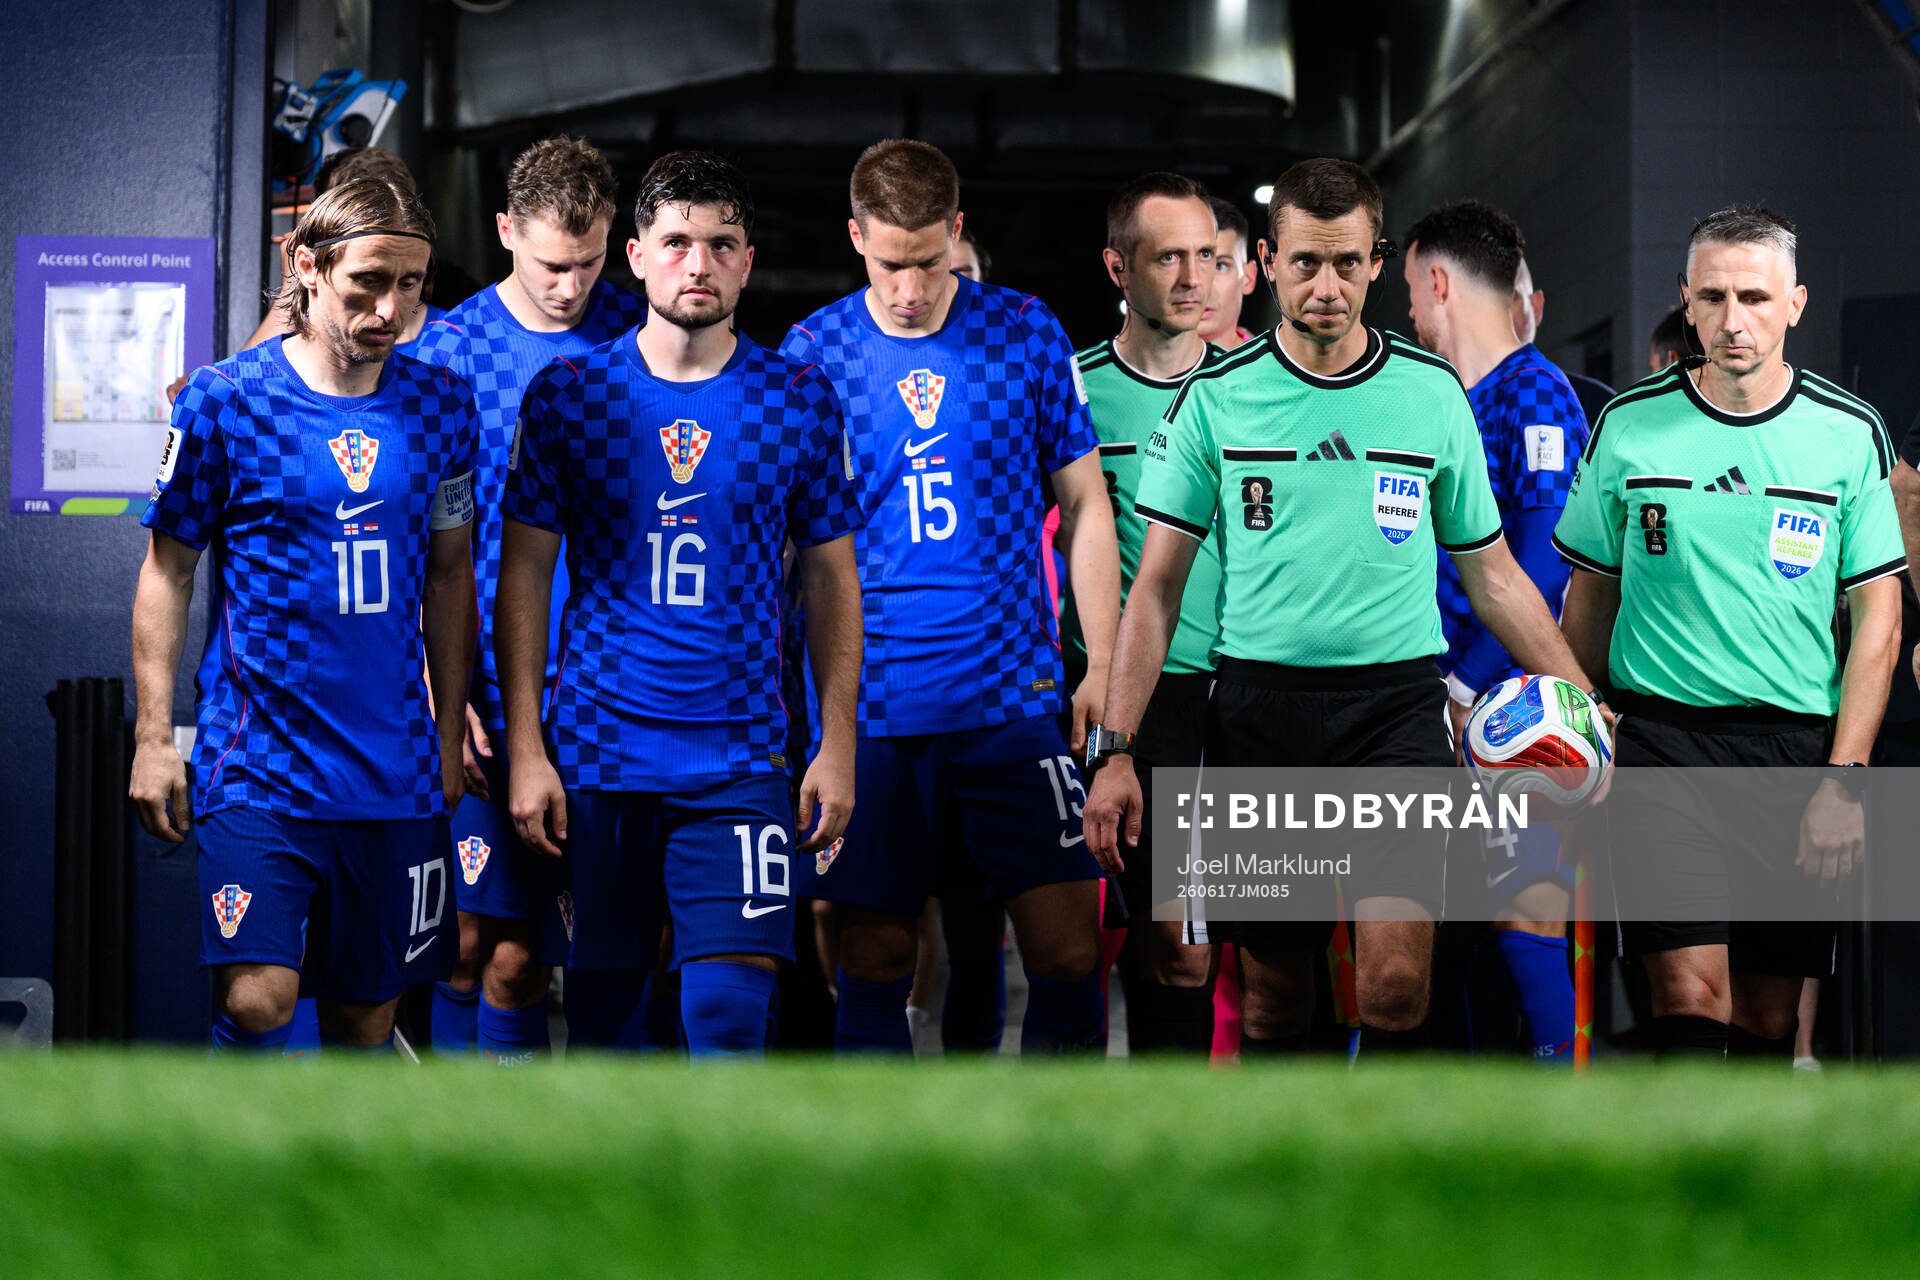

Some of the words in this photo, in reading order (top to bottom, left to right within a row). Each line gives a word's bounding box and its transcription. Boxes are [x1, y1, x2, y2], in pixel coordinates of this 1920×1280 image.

[38, 252, 88, 267] Access
[92, 252, 149, 268] Control
[151, 253, 191, 269] Point
[1379, 476, 1420, 498] FIFA
[24, 500, 50, 513] FIFA
[902, 471, 957, 543] 15
[1378, 504, 1418, 518] REFEREE
[1251, 519, 1265, 527] FIFA
[1777, 512, 1821, 537] FIFA
[1387, 529, 1406, 540] 2026
[1775, 536, 1818, 551] ASSISTANT
[1776, 545, 1813, 559] REFEREE
[331, 539, 389, 615] 10
[647, 532, 707, 607] 16
[1781, 564, 1802, 575] 2026
[1039, 755, 1088, 820] 15
[734, 824, 790, 896] 16
[408, 857, 445, 936] 10
[498, 1051, 534, 1067] HNS
[1533, 1044, 1555, 1058] NS
